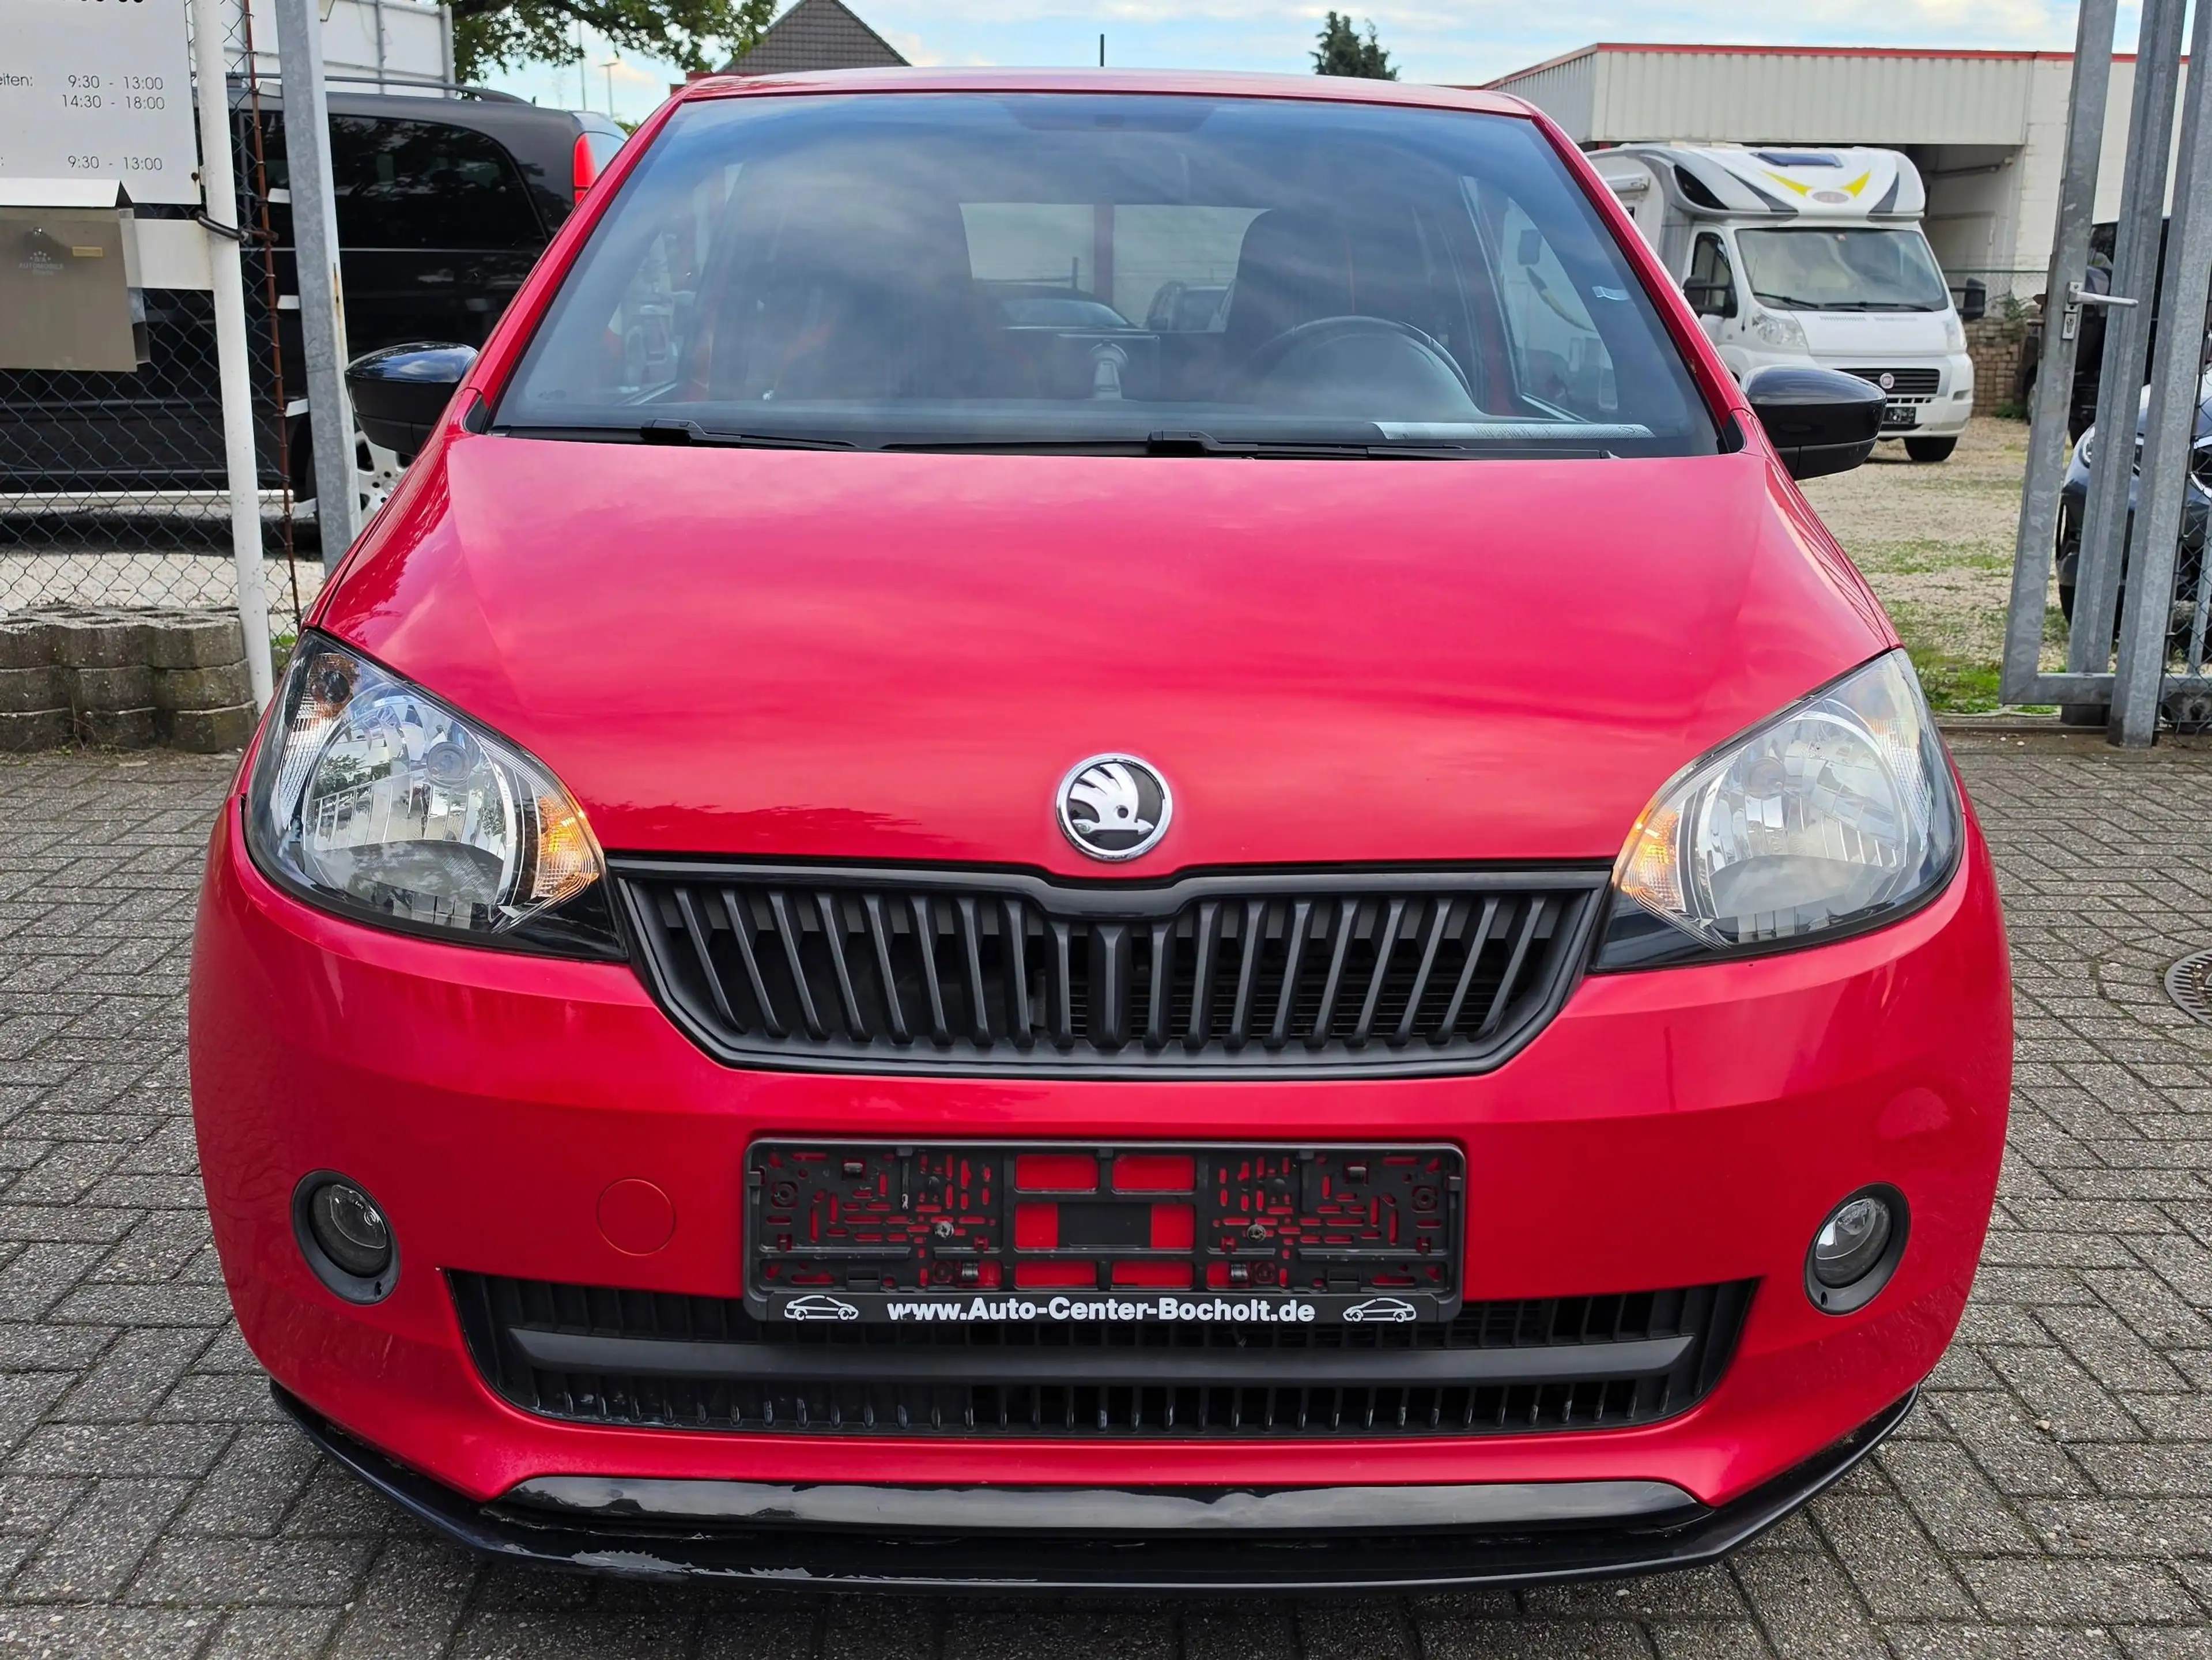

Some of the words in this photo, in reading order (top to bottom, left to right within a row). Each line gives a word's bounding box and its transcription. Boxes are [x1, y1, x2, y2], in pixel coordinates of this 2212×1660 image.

[68, 74, 100, 89] 9:30
[123, 76, 163, 90] 13:00
[62, 94, 102, 108] 14:30
[126, 96, 165, 110] 18:00
[67, 155, 99, 169] 9:30
[123, 157, 163, 171] 13:00
[887, 1296, 1315, 1322] www.Auto-Center-Bocholt.de
